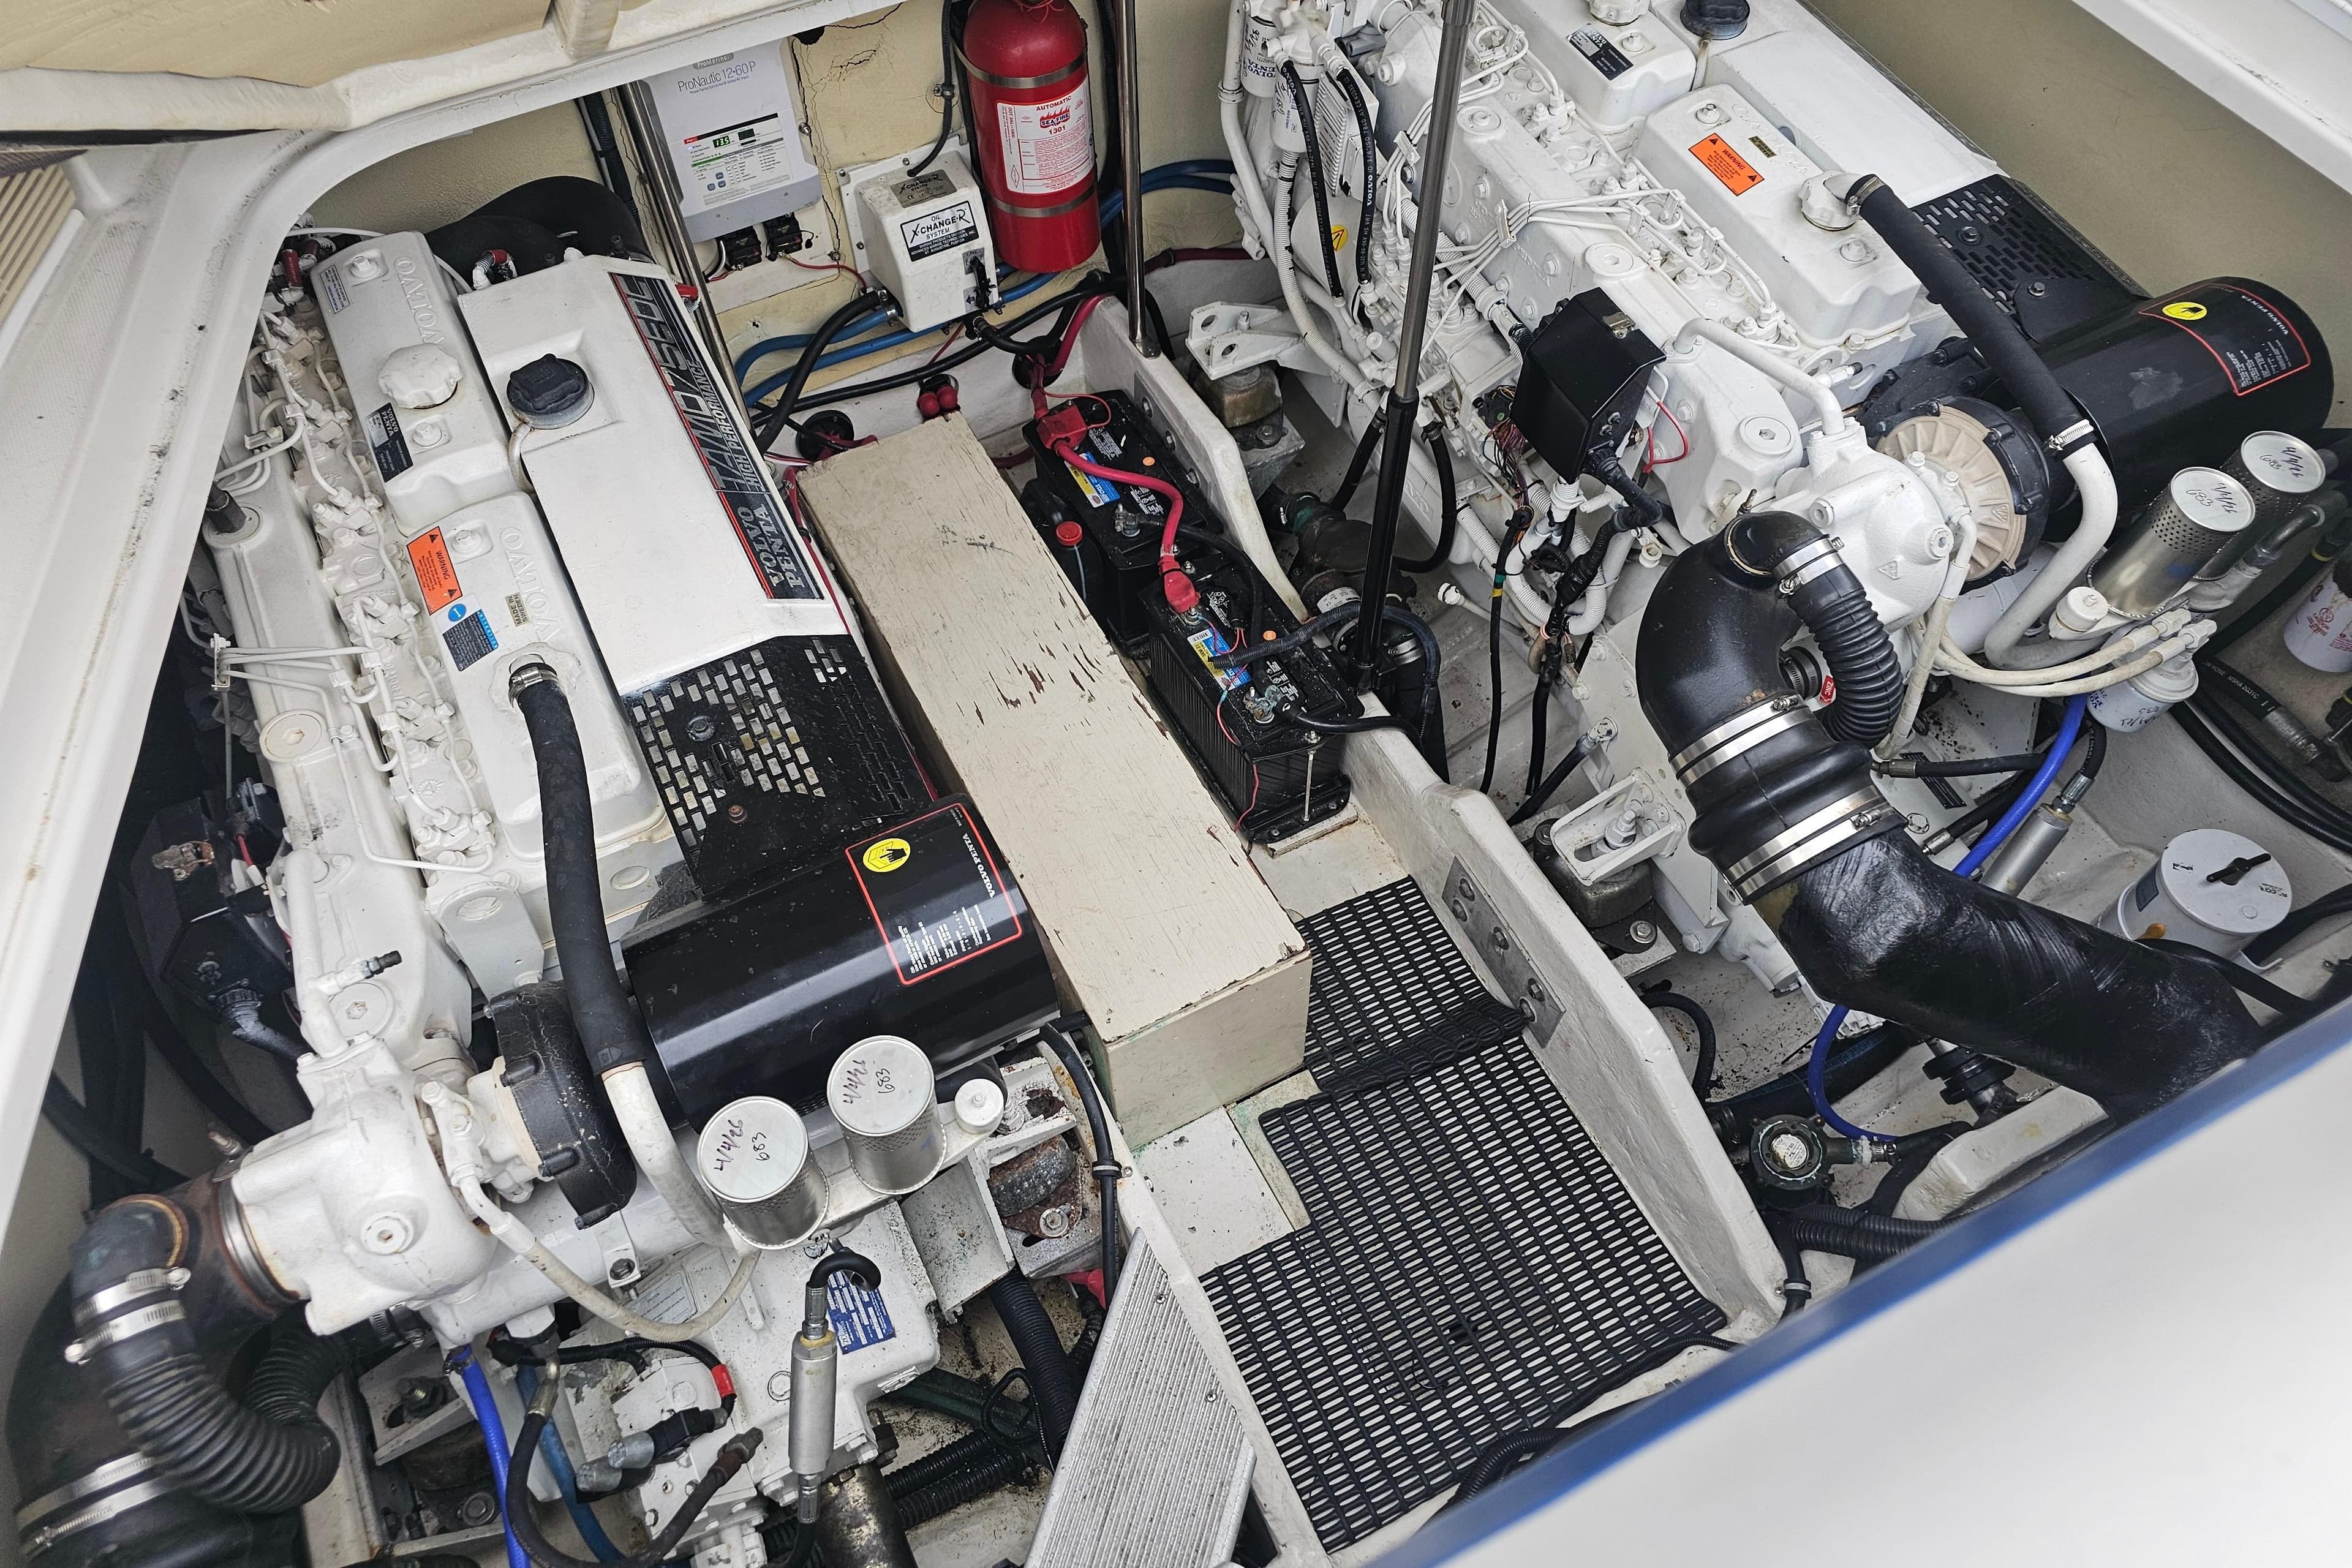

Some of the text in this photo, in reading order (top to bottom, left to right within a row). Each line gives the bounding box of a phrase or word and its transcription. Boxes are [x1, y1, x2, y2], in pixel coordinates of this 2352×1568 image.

[1586, 31, 1604, 48] ENTA
[1591, 29, 1607, 44] OLVO
[698, 54, 731, 68] ProMariner
[1248, 59, 1276, 72] ENTA
[1248, 66, 1275, 78] OLVO
[677, 72, 721, 92] ProNautic
[1281, 66, 1298, 95] VOLVO
[1036, 96, 1072, 111] AUTOMATIC
[1049, 126, 1066, 135] 1301
[1360, 118, 1369, 134] 7840
[1721, 148, 1746, 171] WARNING
[926, 227, 950, 240] SYSTEM
[390, 252, 446, 347] VOLVO
[2242, 295, 2288, 336] VOLVO PENTA
[380, 410, 395, 437] PENTA
[385, 407, 399, 432] VOLVO
[694, 359, 757, 486] HIGH PERFORMANCE
[1095, 483, 1105, 495] CYCLE
[2186, 489, 2214, 507] 683
[737, 505, 780, 587] VOLVO
[758, 503, 806, 589] PENTA
[433, 549, 452, 581] WARNING
[494, 523, 564, 643] VOLVO
[508, 596, 522, 625] MADE IN
[514, 594, 528, 624] SWEDEN
[479, 613, 498, 648] ATTENTION
[2210, 663, 2226, 677] HOSE
[1822, 680, 1836, 696] ZINC
[961, 831, 997, 898] VOLVO PENTA
[876, 1068, 895, 1094] 683
[752, 1132, 770, 1161] 683
